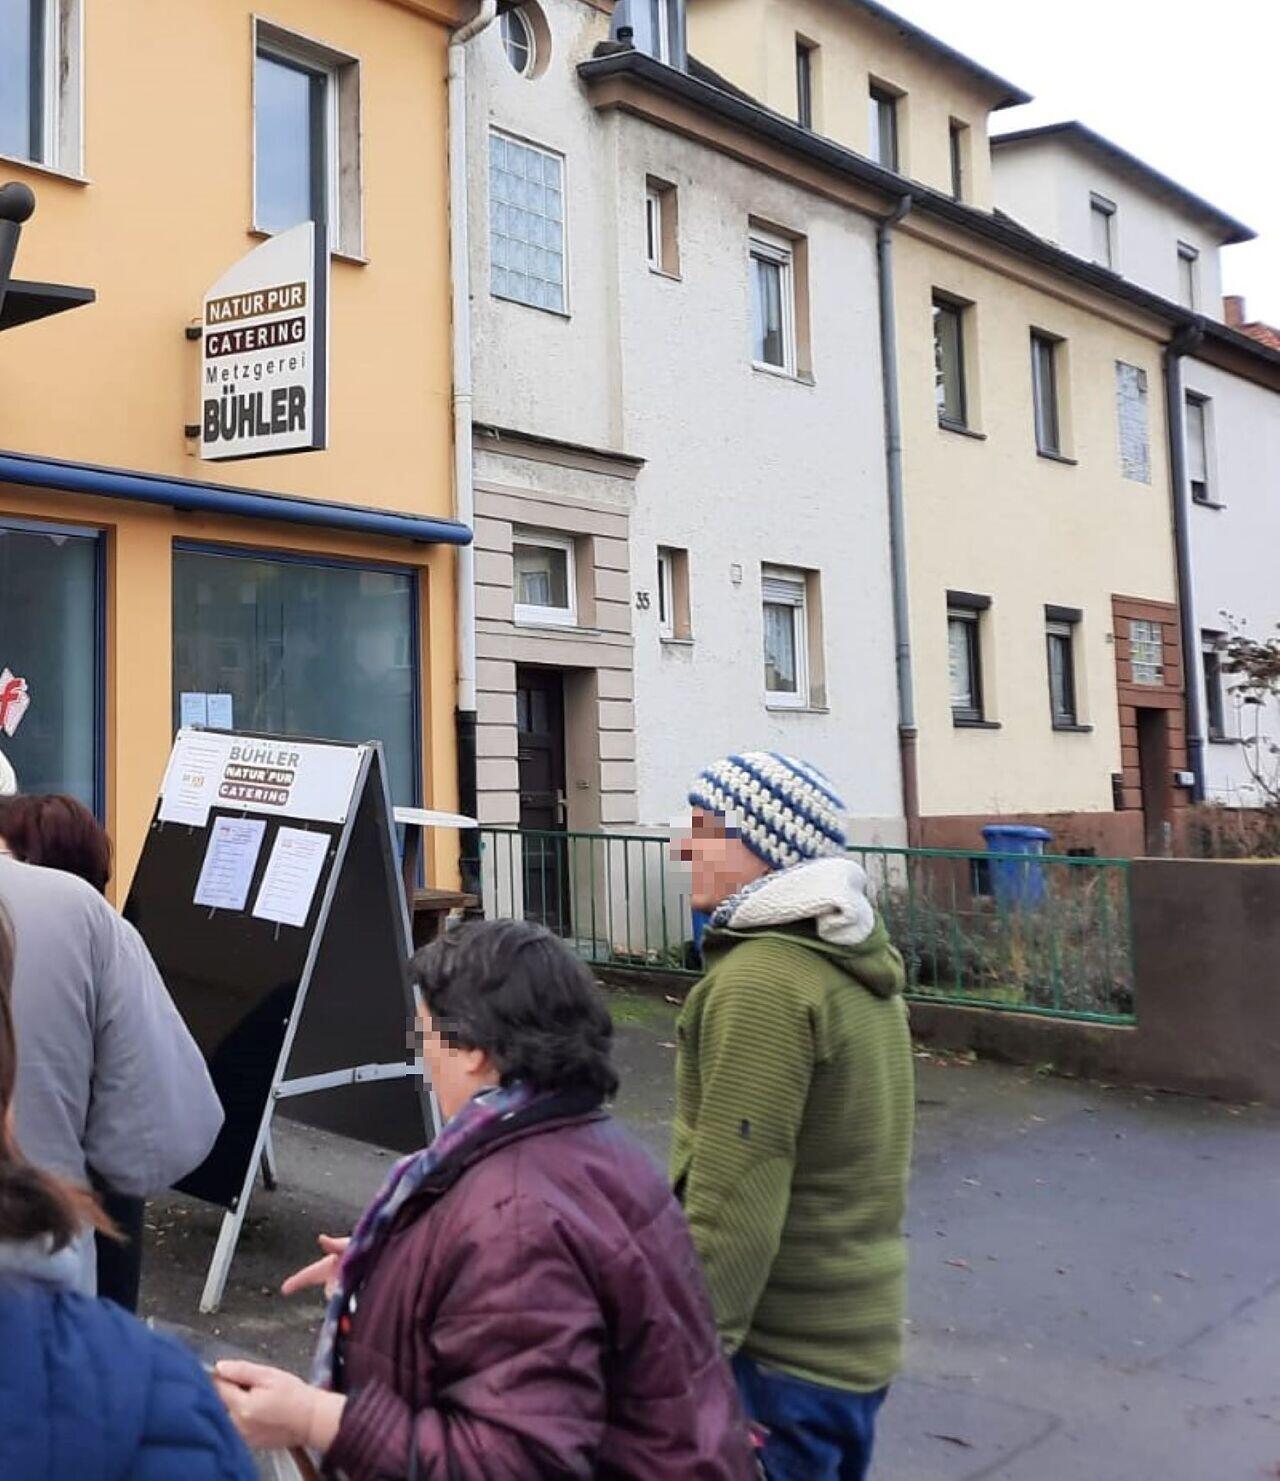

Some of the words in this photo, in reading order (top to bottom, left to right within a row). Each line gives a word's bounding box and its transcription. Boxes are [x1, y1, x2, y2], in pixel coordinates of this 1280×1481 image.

[209, 294, 264, 323] NATUR
[267, 286, 303, 312] PUR
[208, 320, 303, 355] CATERING
[206, 351, 305, 384] Metzgerei
[203, 384, 306, 443] BÜHLER
[635, 591, 650, 610] 35
[225, 766, 266, 782] NATUR
[268, 770, 294, 784] PUR
[220, 784, 288, 804] CATERING
